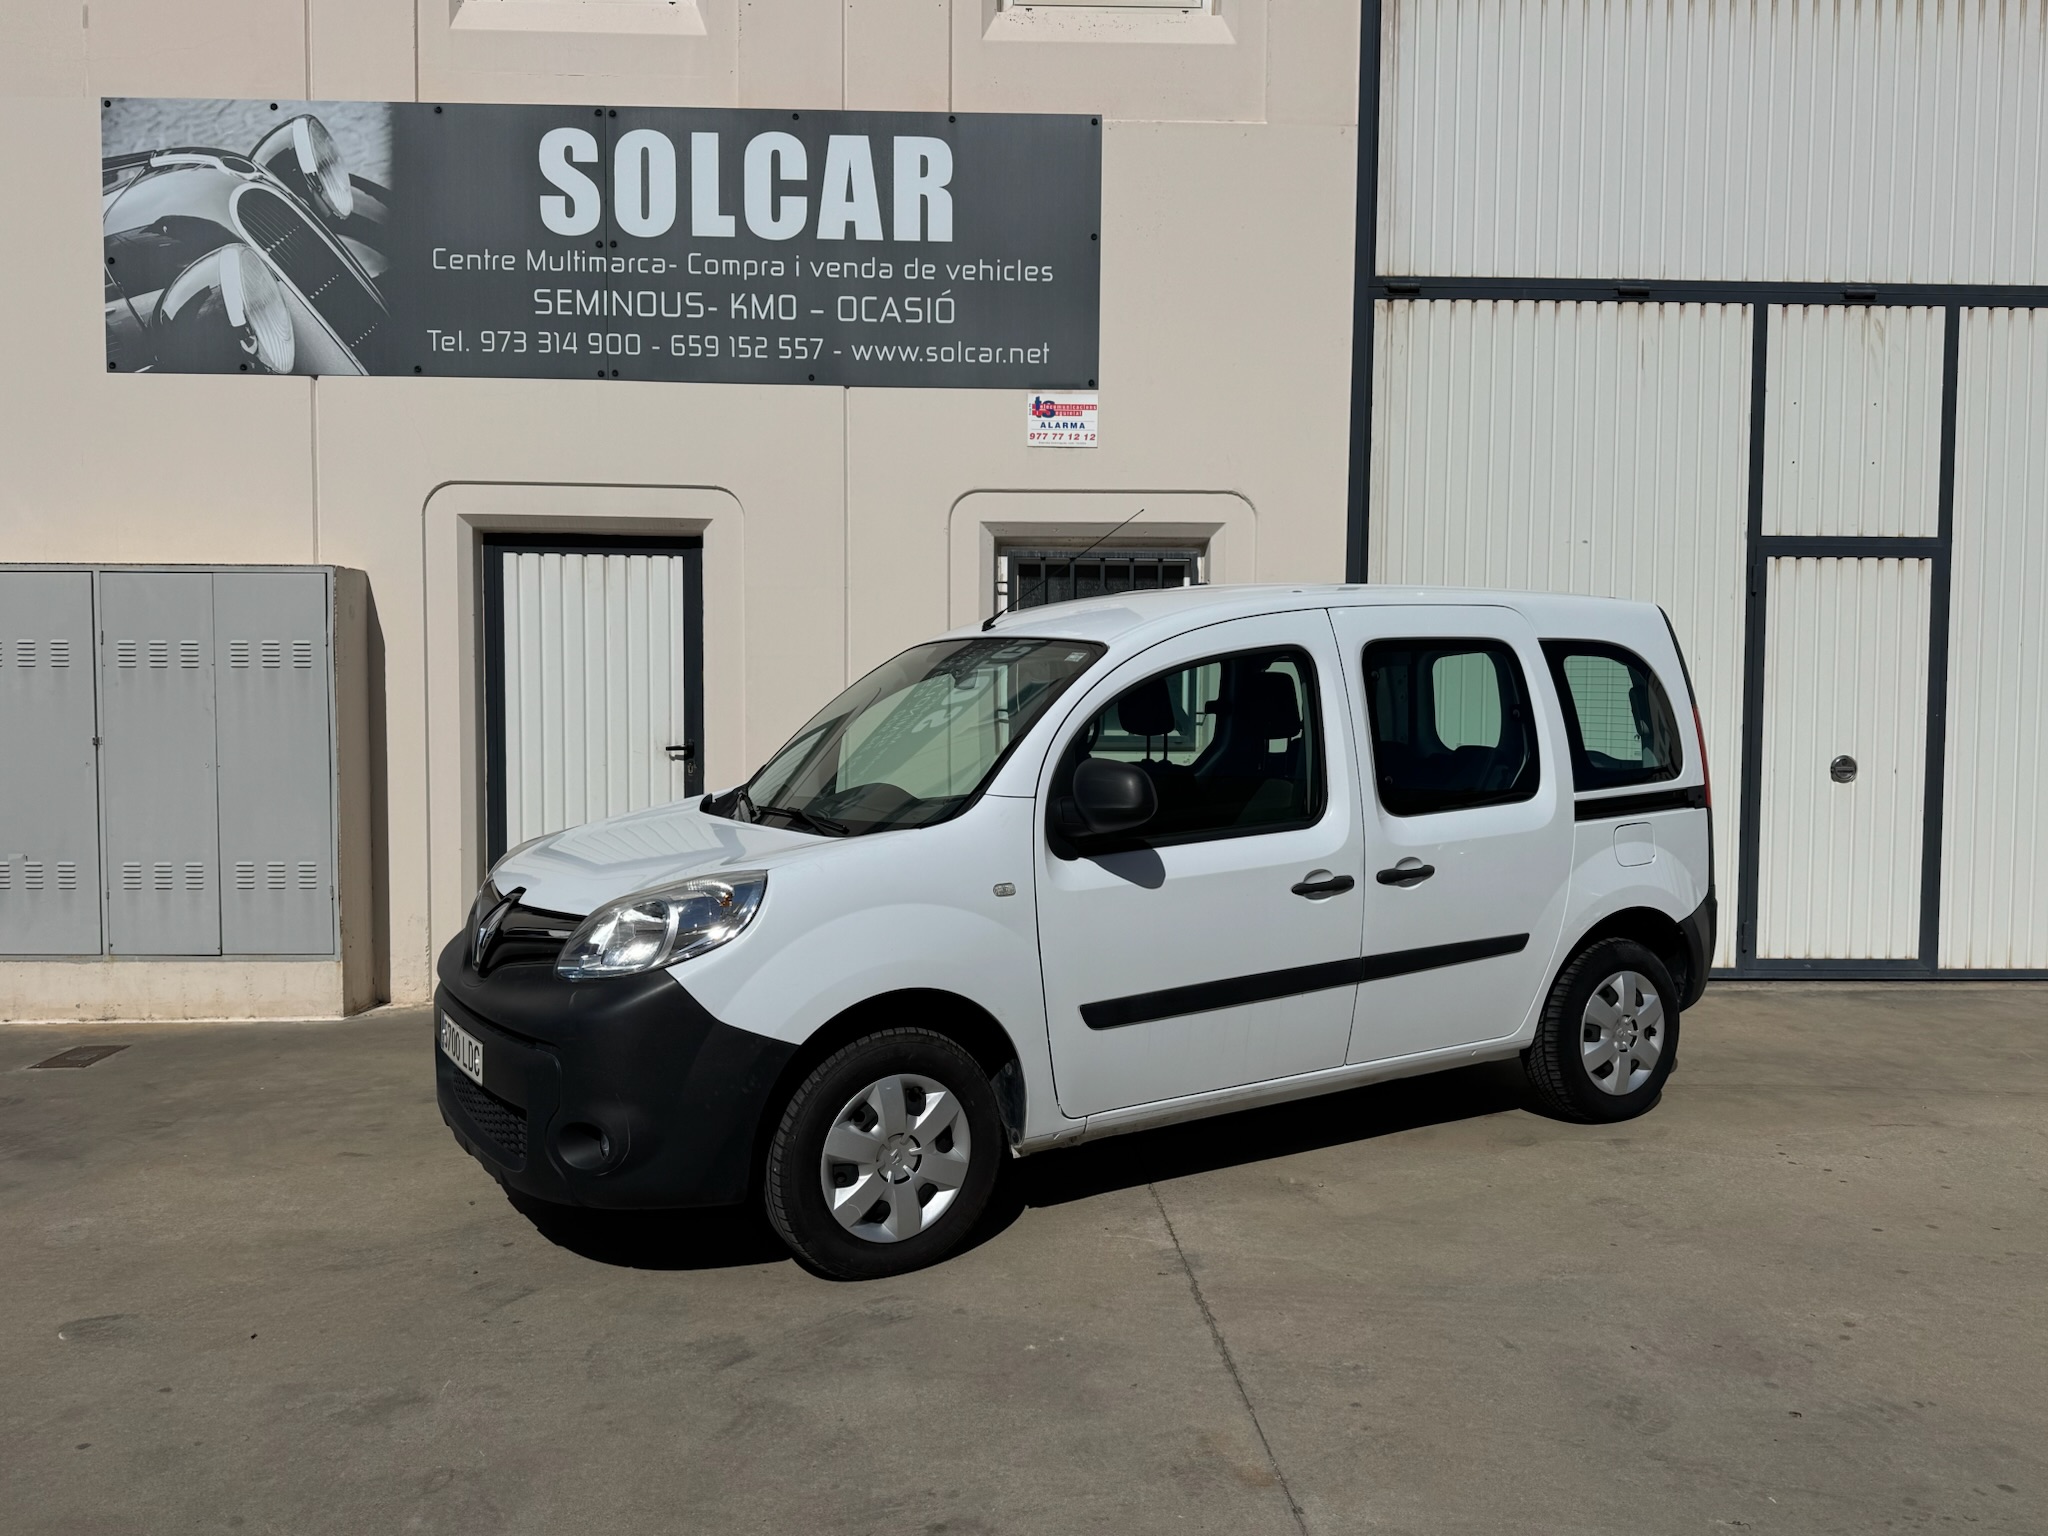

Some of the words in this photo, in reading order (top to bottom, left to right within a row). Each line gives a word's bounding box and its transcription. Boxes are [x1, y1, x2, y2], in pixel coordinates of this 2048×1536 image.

[538, 127, 954, 243] SOLCAR
[432, 247, 516, 271] Centre
[526, 248, 678, 274] Multimarca-
[687, 252, 785, 281] Compra
[795, 254, 800, 277] i
[809, 256, 893, 279] venda
[904, 257, 936, 280] de
[945, 258, 1054, 282] vehicles
[533, 288, 718, 318] SEMINOUS-
[837, 288, 955, 324] OCASIÓ
[426, 329, 470, 352] Tel.
[480, 330, 527, 353] 973
[538, 331, 578, 354] 314
[587, 332, 641, 356] 900
[670, 334, 719, 357] 659
[728, 335, 768, 359] 152
[778, 336, 824, 360] 557
[851, 340, 1050, 364] www.solcar.net
[1029, 432, 1048, 440] 977
[1068, 433, 1080, 441] 12
[1084, 433, 1096, 441] 12
[1040, 421, 1085, 429] ALARMA
[462, 1035, 480, 1077] LDC
